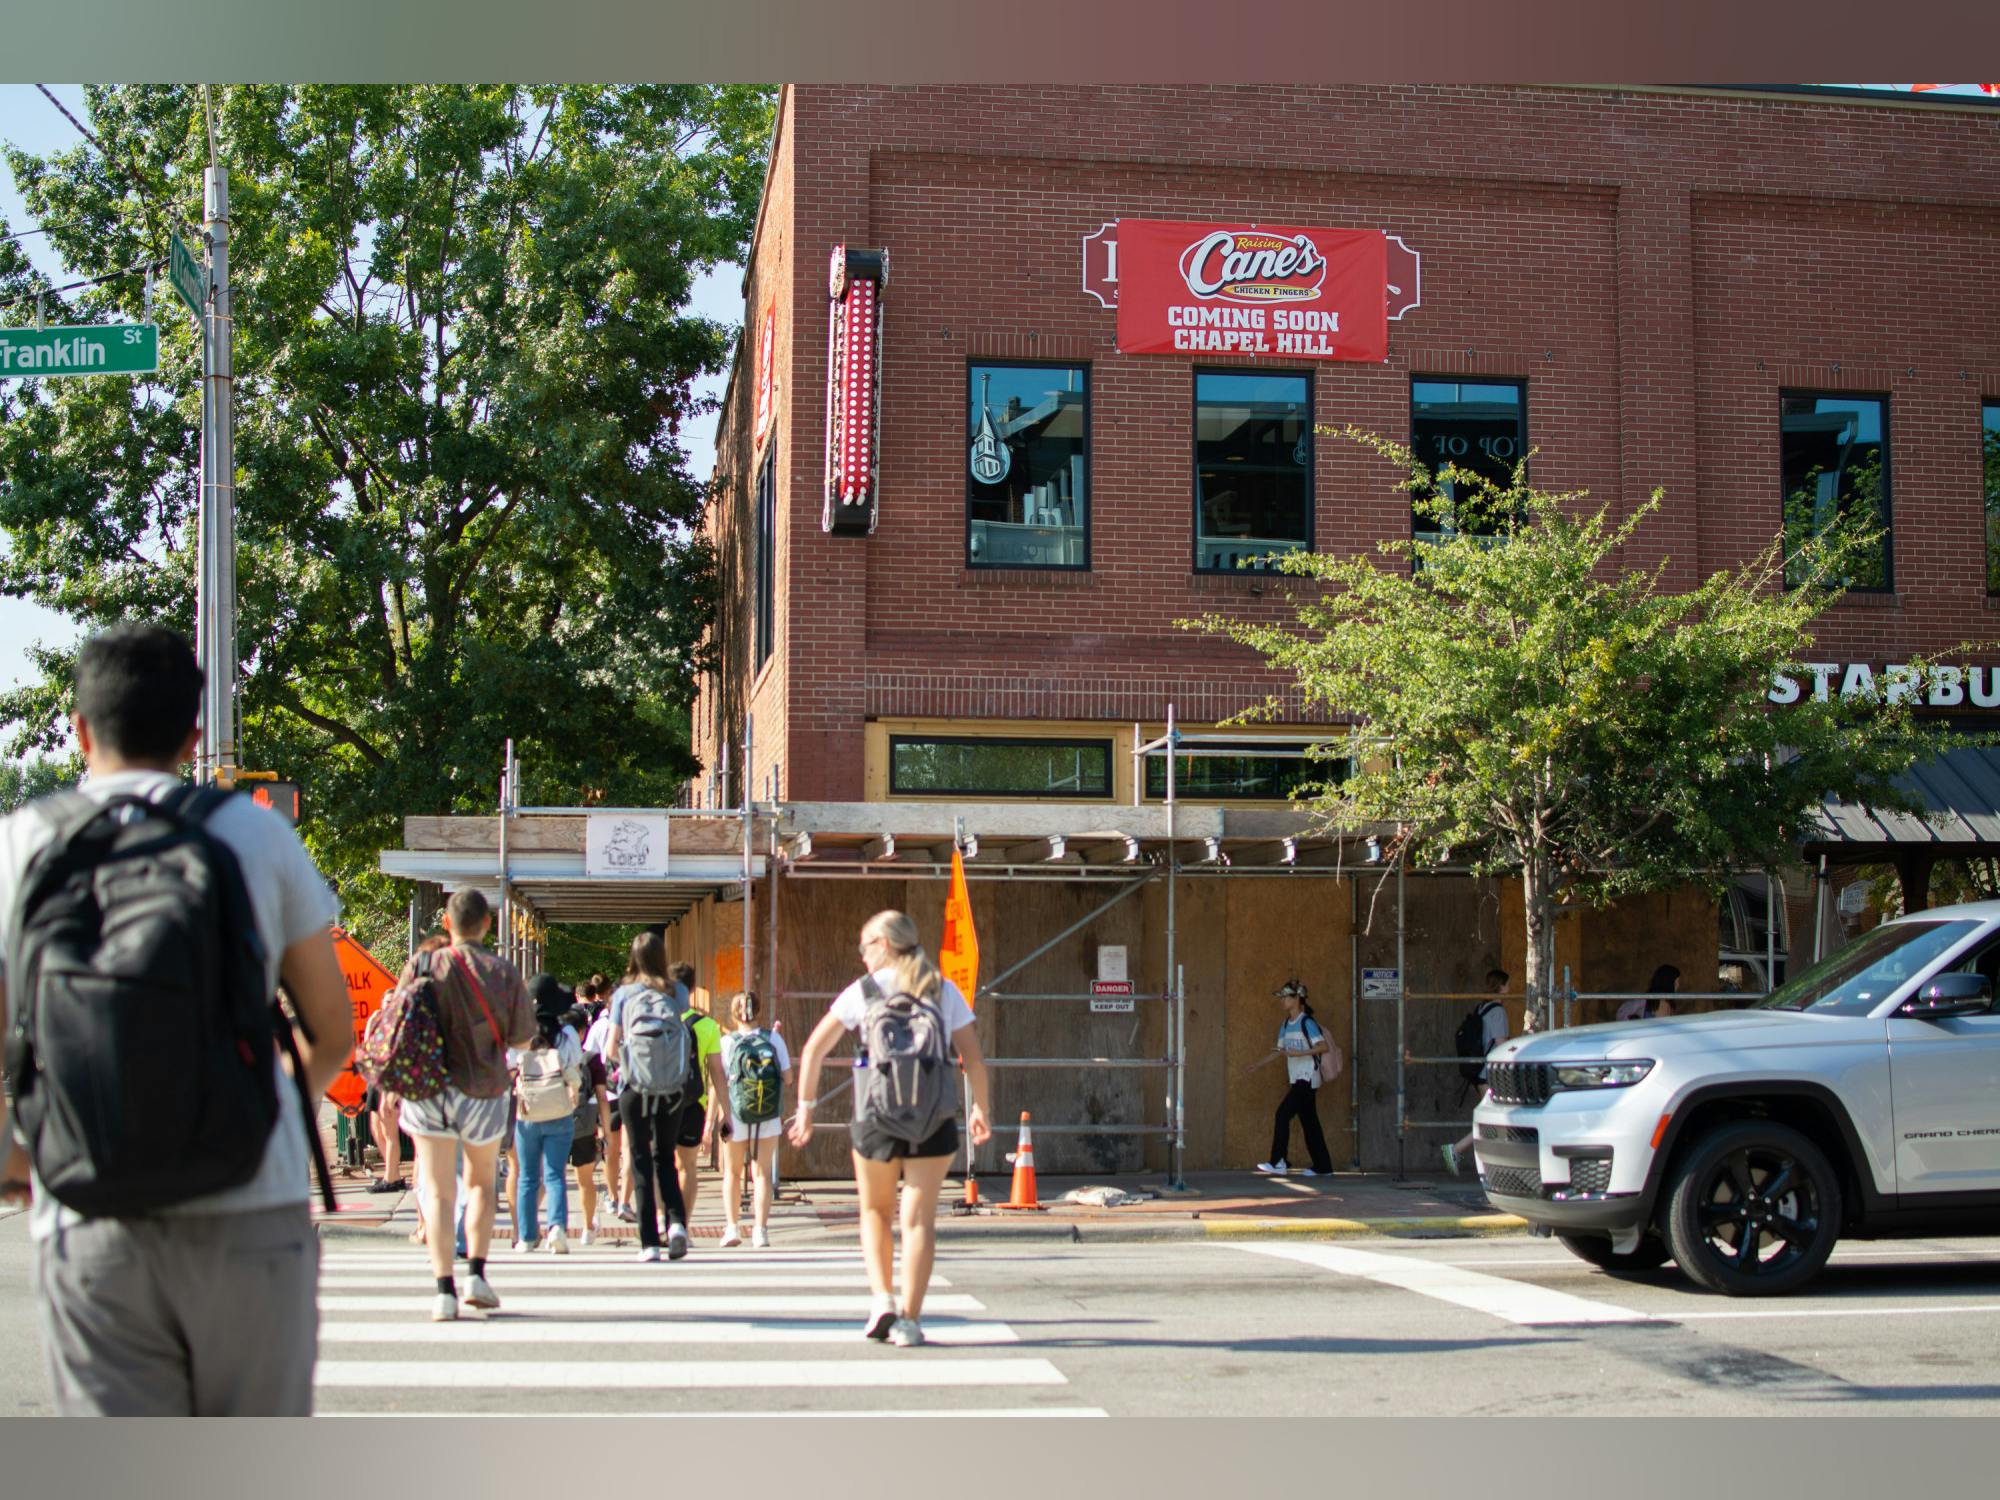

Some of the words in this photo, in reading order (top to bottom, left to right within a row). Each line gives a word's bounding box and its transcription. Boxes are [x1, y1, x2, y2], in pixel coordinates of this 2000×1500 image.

[1236, 236, 1283, 250] Raising
[1188, 232, 1320, 294] Cane's
[1233, 285, 1270, 295] CHICKEN
[1273, 286, 1309, 297] FINGERS
[1168, 306, 1265, 329] COMING
[1274, 310, 1339, 332] SOON
[122, 328, 142, 344] St
[1174, 329, 1270, 353] CHAPEL
[1277, 333, 1333, 355] HILL
[1767, 662, 2000, 708] STARBU
[1095, 985, 1129, 993] DANGER
[1904, 1130, 1953, 1139] GRAND
